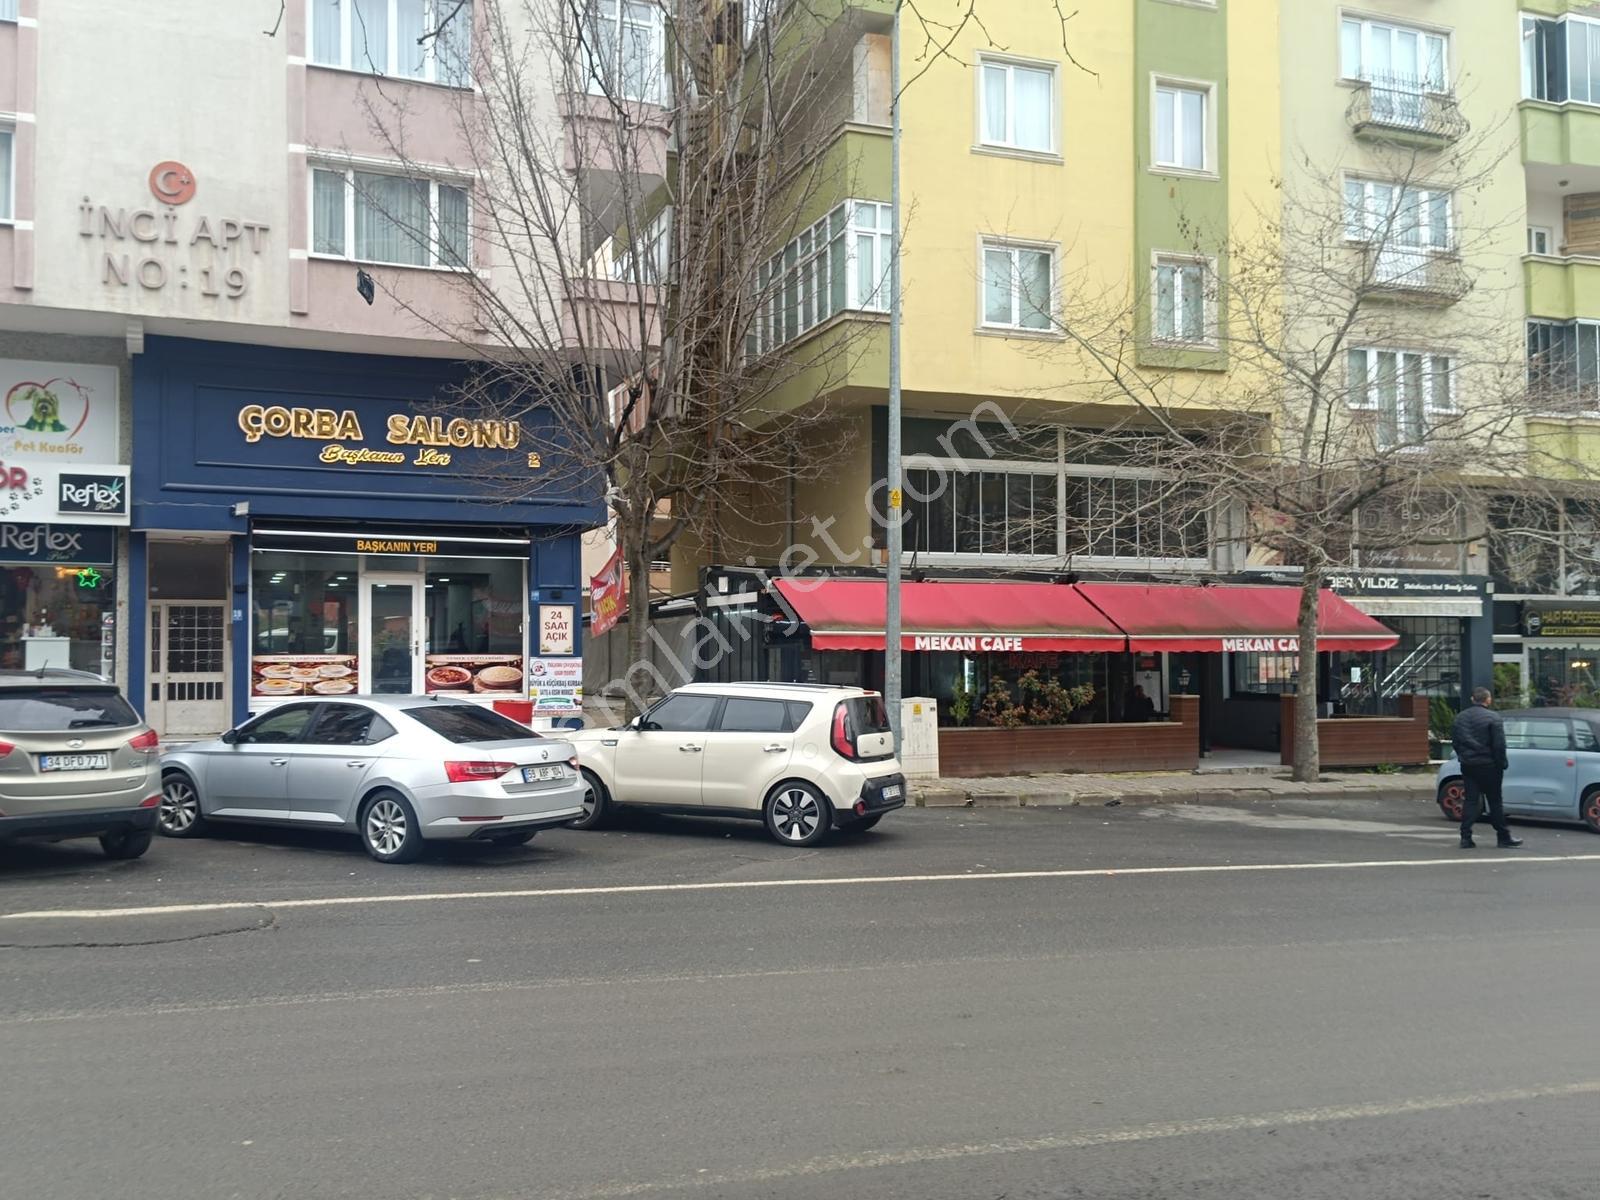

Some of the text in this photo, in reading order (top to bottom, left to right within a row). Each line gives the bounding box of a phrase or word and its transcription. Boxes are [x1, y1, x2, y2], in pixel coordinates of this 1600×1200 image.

[79, 196, 270, 255] İNCİ APT
[238, 405, 520, 449] ÇORBA SALONU
[14, 440, 36, 453] Pet
[319, 443, 451, 466] Başkanın Yeri
[528, 452, 541, 468] 2
[62, 483, 121, 507] Reflex
[0, 525, 82, 556] Reflex
[356, 540, 437, 553] BAŞKANIN YERİ
[1358, 577, 1399, 589] YILDIZ
[550, 610, 562, 619] 24
[544, 621, 568, 630] SAAT
[545, 632, 568, 642] AÇIK
[915, 636, 1022, 651] MEKAN CAFE
[1222, 639, 1275, 651] MEKAN
[47, 757, 61, 768] 34
[87, 755, 106, 766] 771
[527, 768, 537, 779] 59
